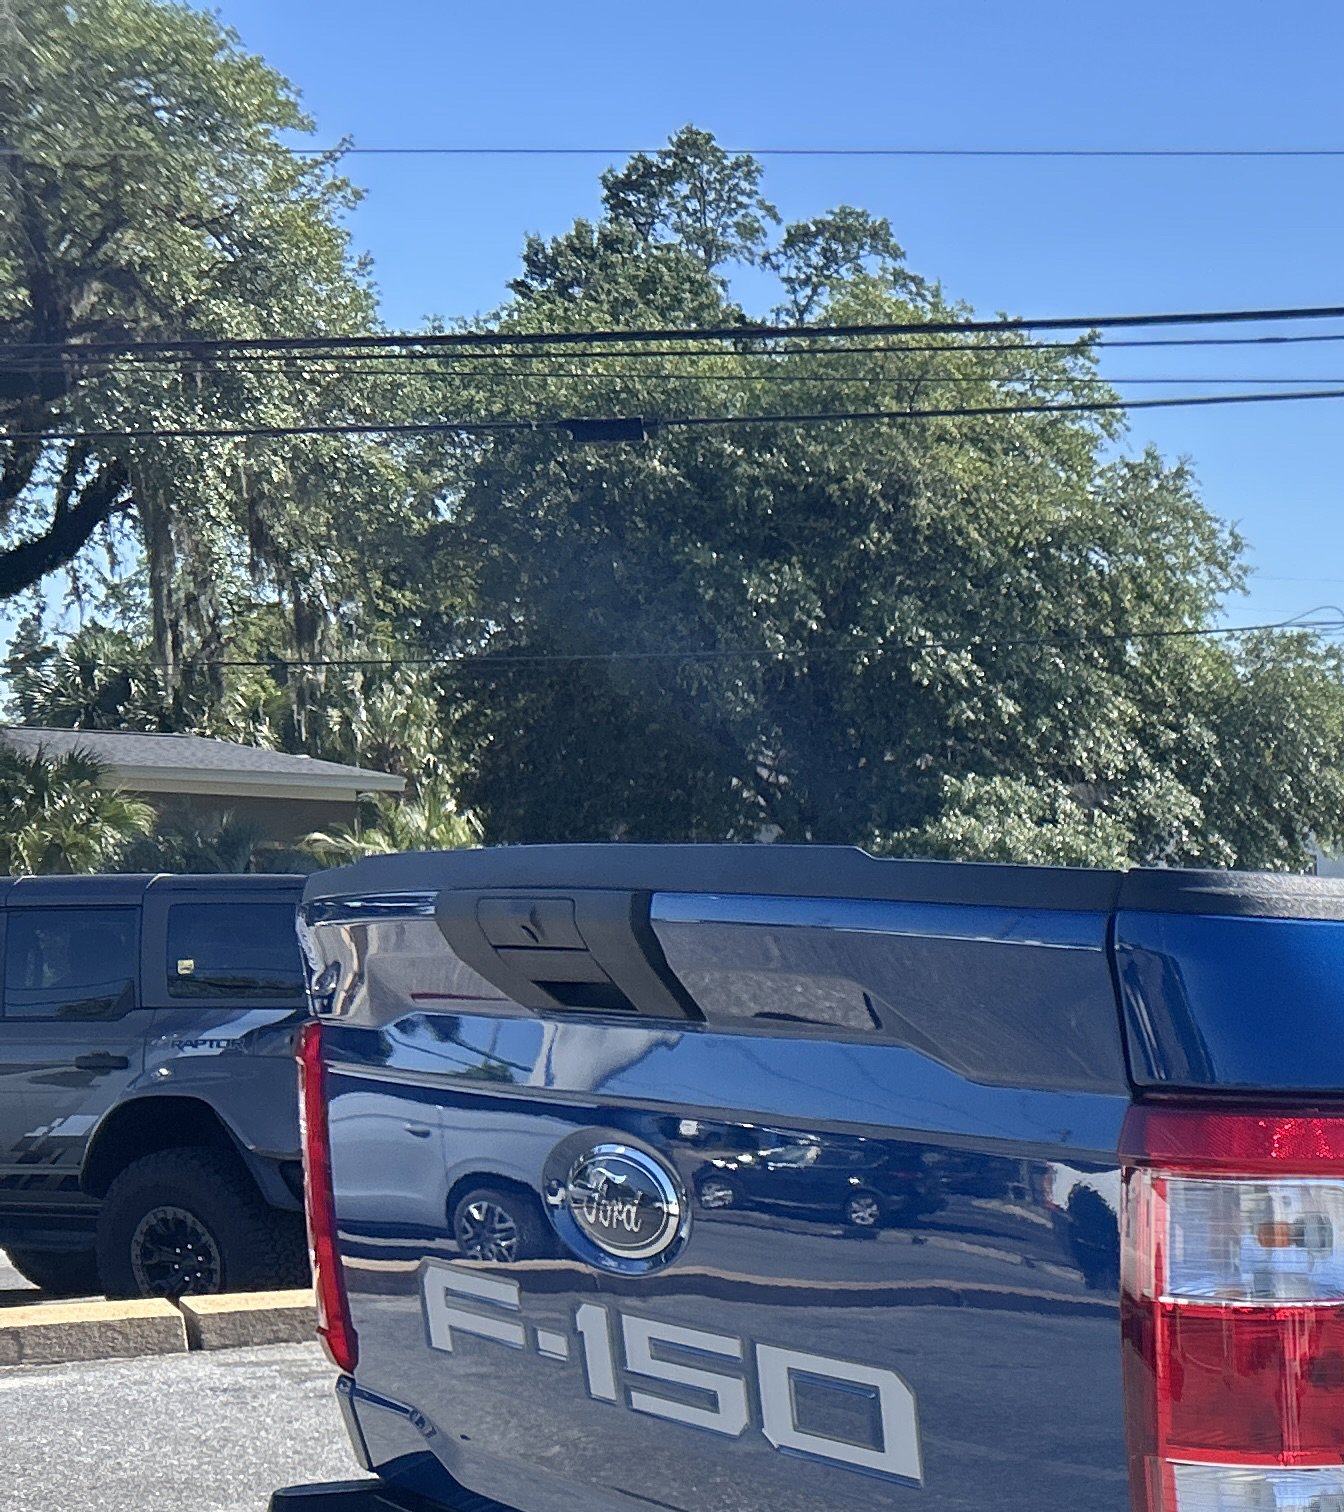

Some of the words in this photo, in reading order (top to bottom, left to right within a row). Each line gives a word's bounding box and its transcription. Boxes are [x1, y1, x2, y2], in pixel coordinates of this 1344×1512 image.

[170, 1038, 249, 1054] RAPTOR
[583, 1165, 643, 1233] Ford
[420, 1257, 923, 1487] F-150
